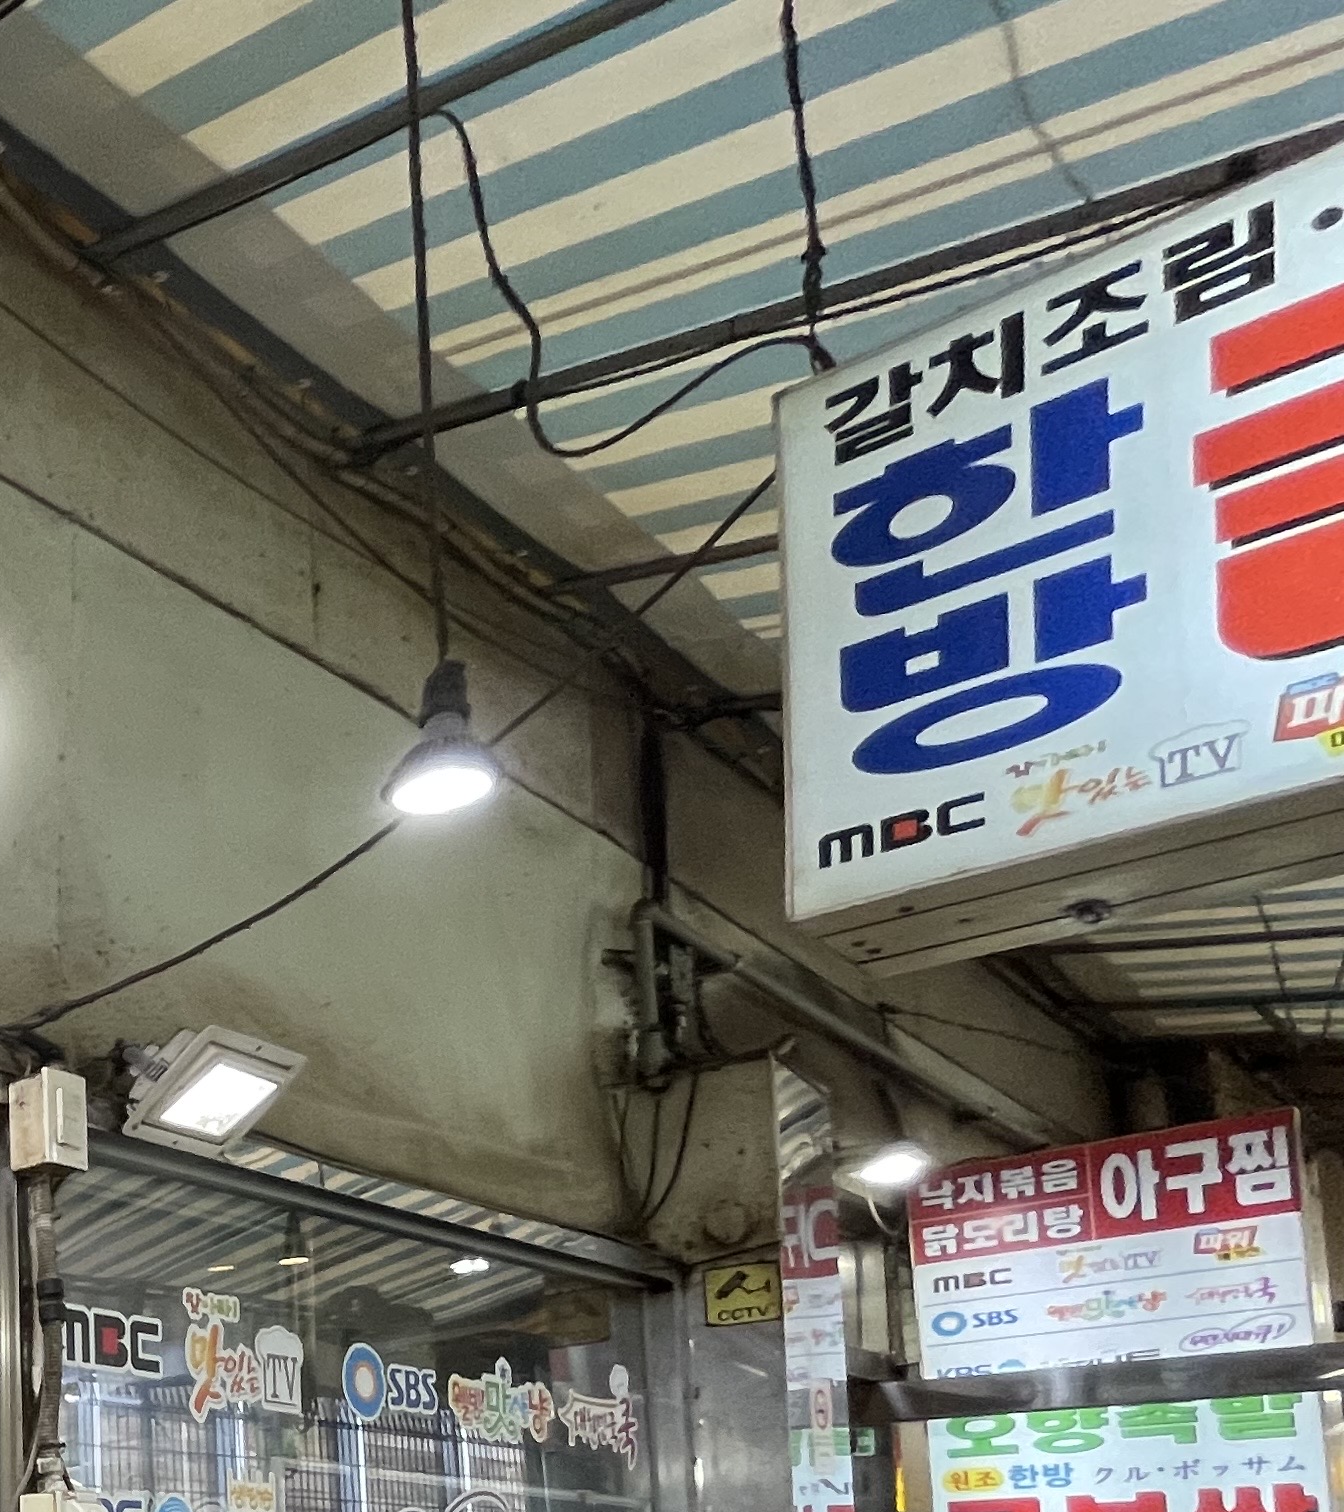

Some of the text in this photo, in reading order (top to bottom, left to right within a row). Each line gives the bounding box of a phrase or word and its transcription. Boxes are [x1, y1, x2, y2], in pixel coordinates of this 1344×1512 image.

[824, 200, 1276, 466] 갈치조림
[831, 377, 1148, 775] 한방
[1168, 733, 1243, 781] TV
[819, 792, 986, 869] MBC
[920, 1126, 1293, 1221] 낙지볶음 아구찜
[922, 1203, 1084, 1257] 닭도리탕
[933, 1267, 1013, 1294] MBC
[717, 1304, 770, 1322] CCTV
[972, 1308, 1020, 1329] SBS
[266, 1352, 299, 1401] TV
[389, 1367, 438, 1413] SBS
[1007, 1462, 1075, 1491] 한방
